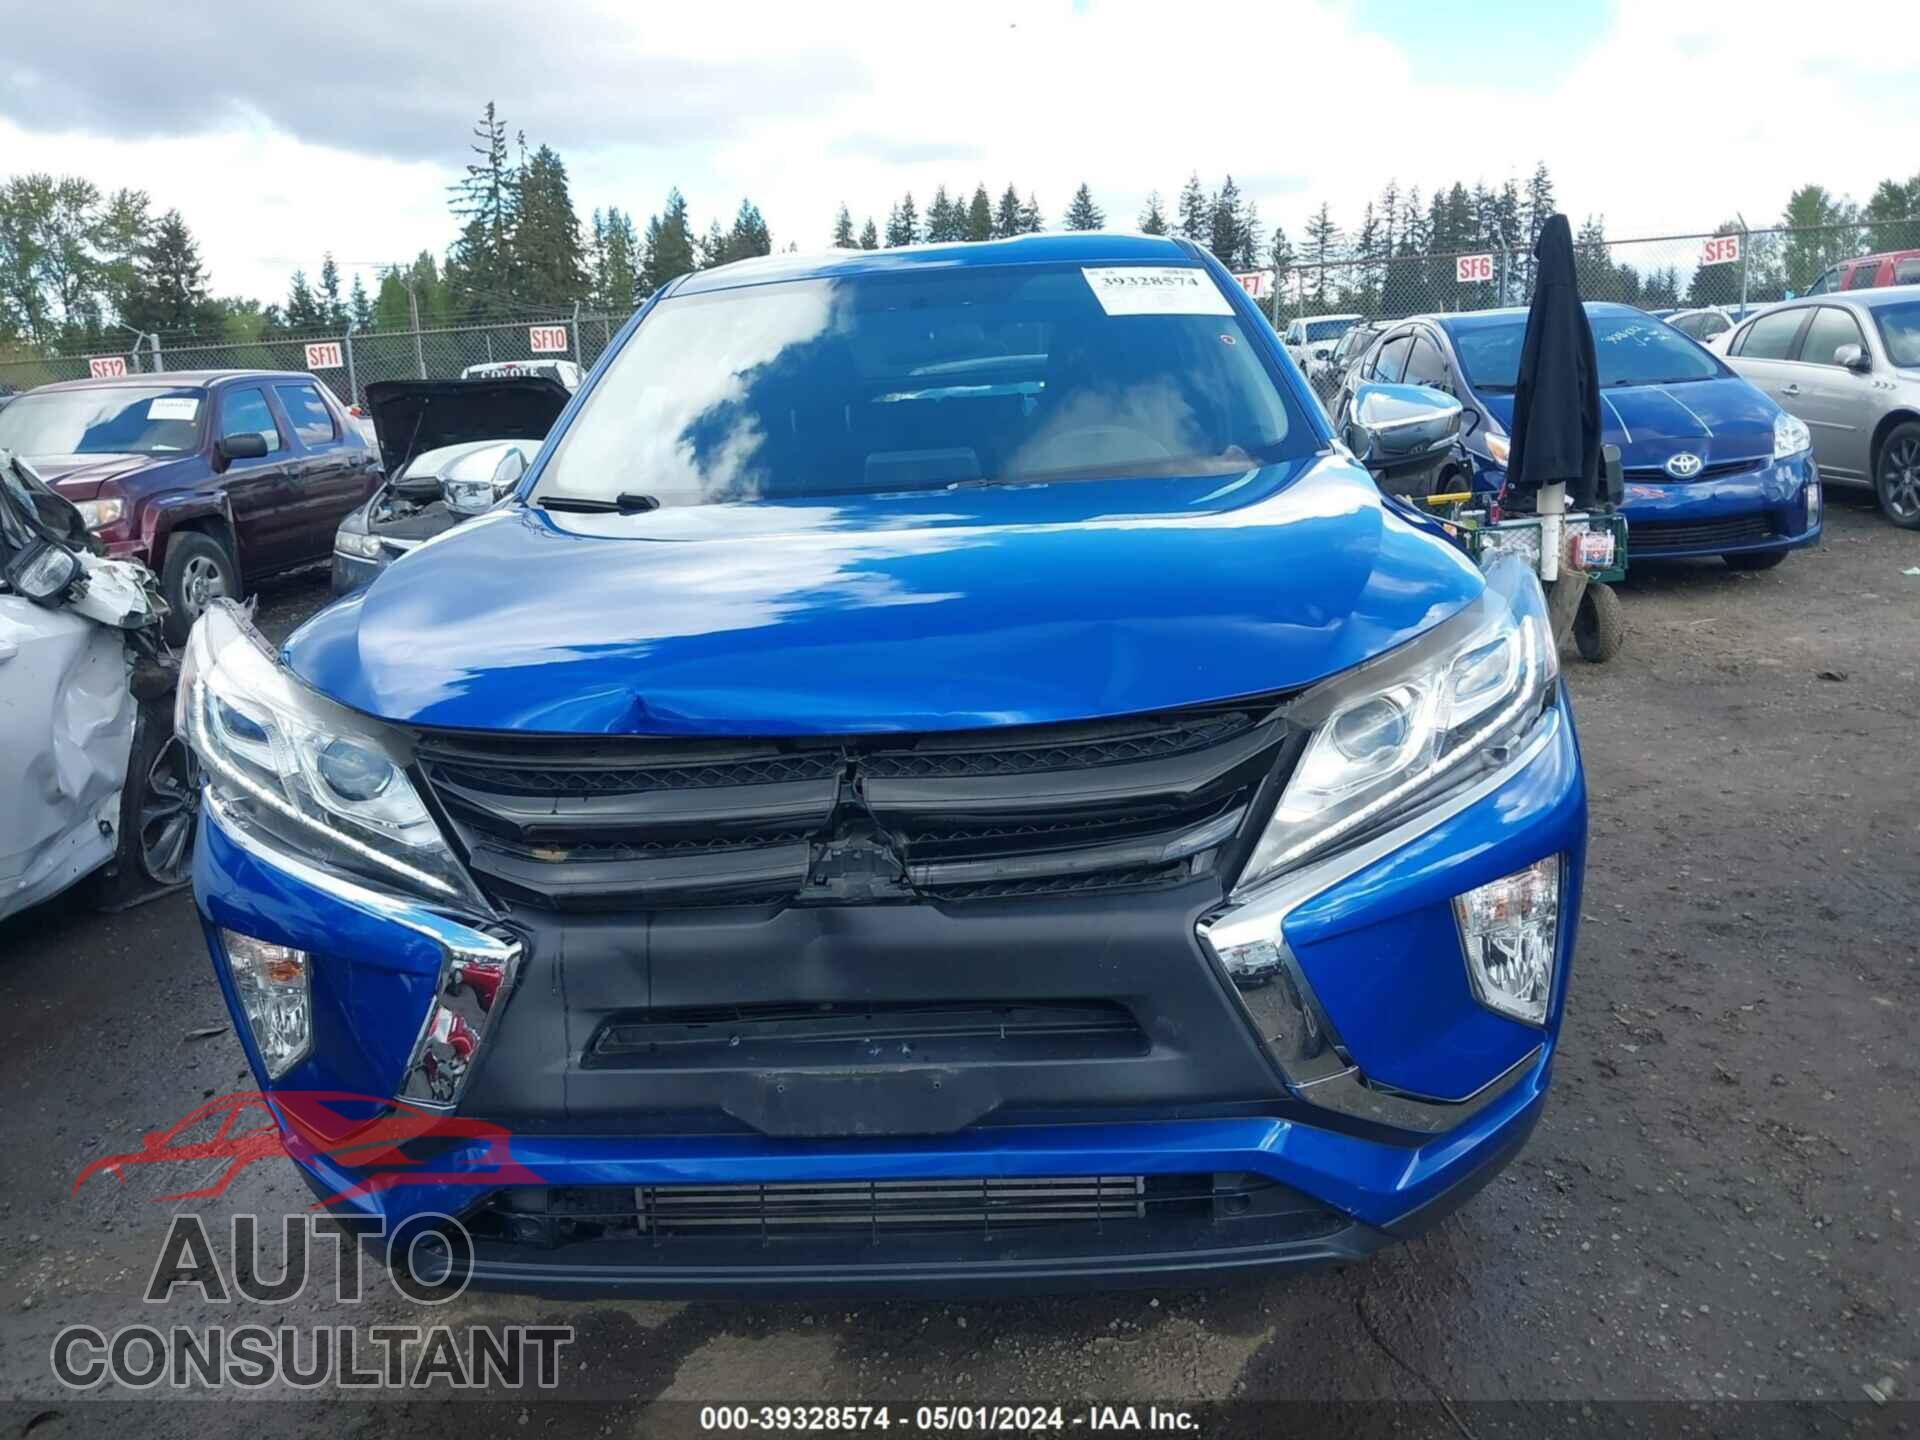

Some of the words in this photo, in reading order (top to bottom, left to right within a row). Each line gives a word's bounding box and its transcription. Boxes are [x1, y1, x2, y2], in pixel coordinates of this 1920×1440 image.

[1705, 239, 1736, 262] SF5
[1460, 257, 1490, 279] SF6
[1102, 276, 1199, 288] 39328574
[1235, 276, 1260, 296] F7
[532, 329, 565, 349] SF10
[309, 345, 338, 366] SF11
[92, 359, 125, 378] SF12
[480, 367, 541, 379] COYOTE
